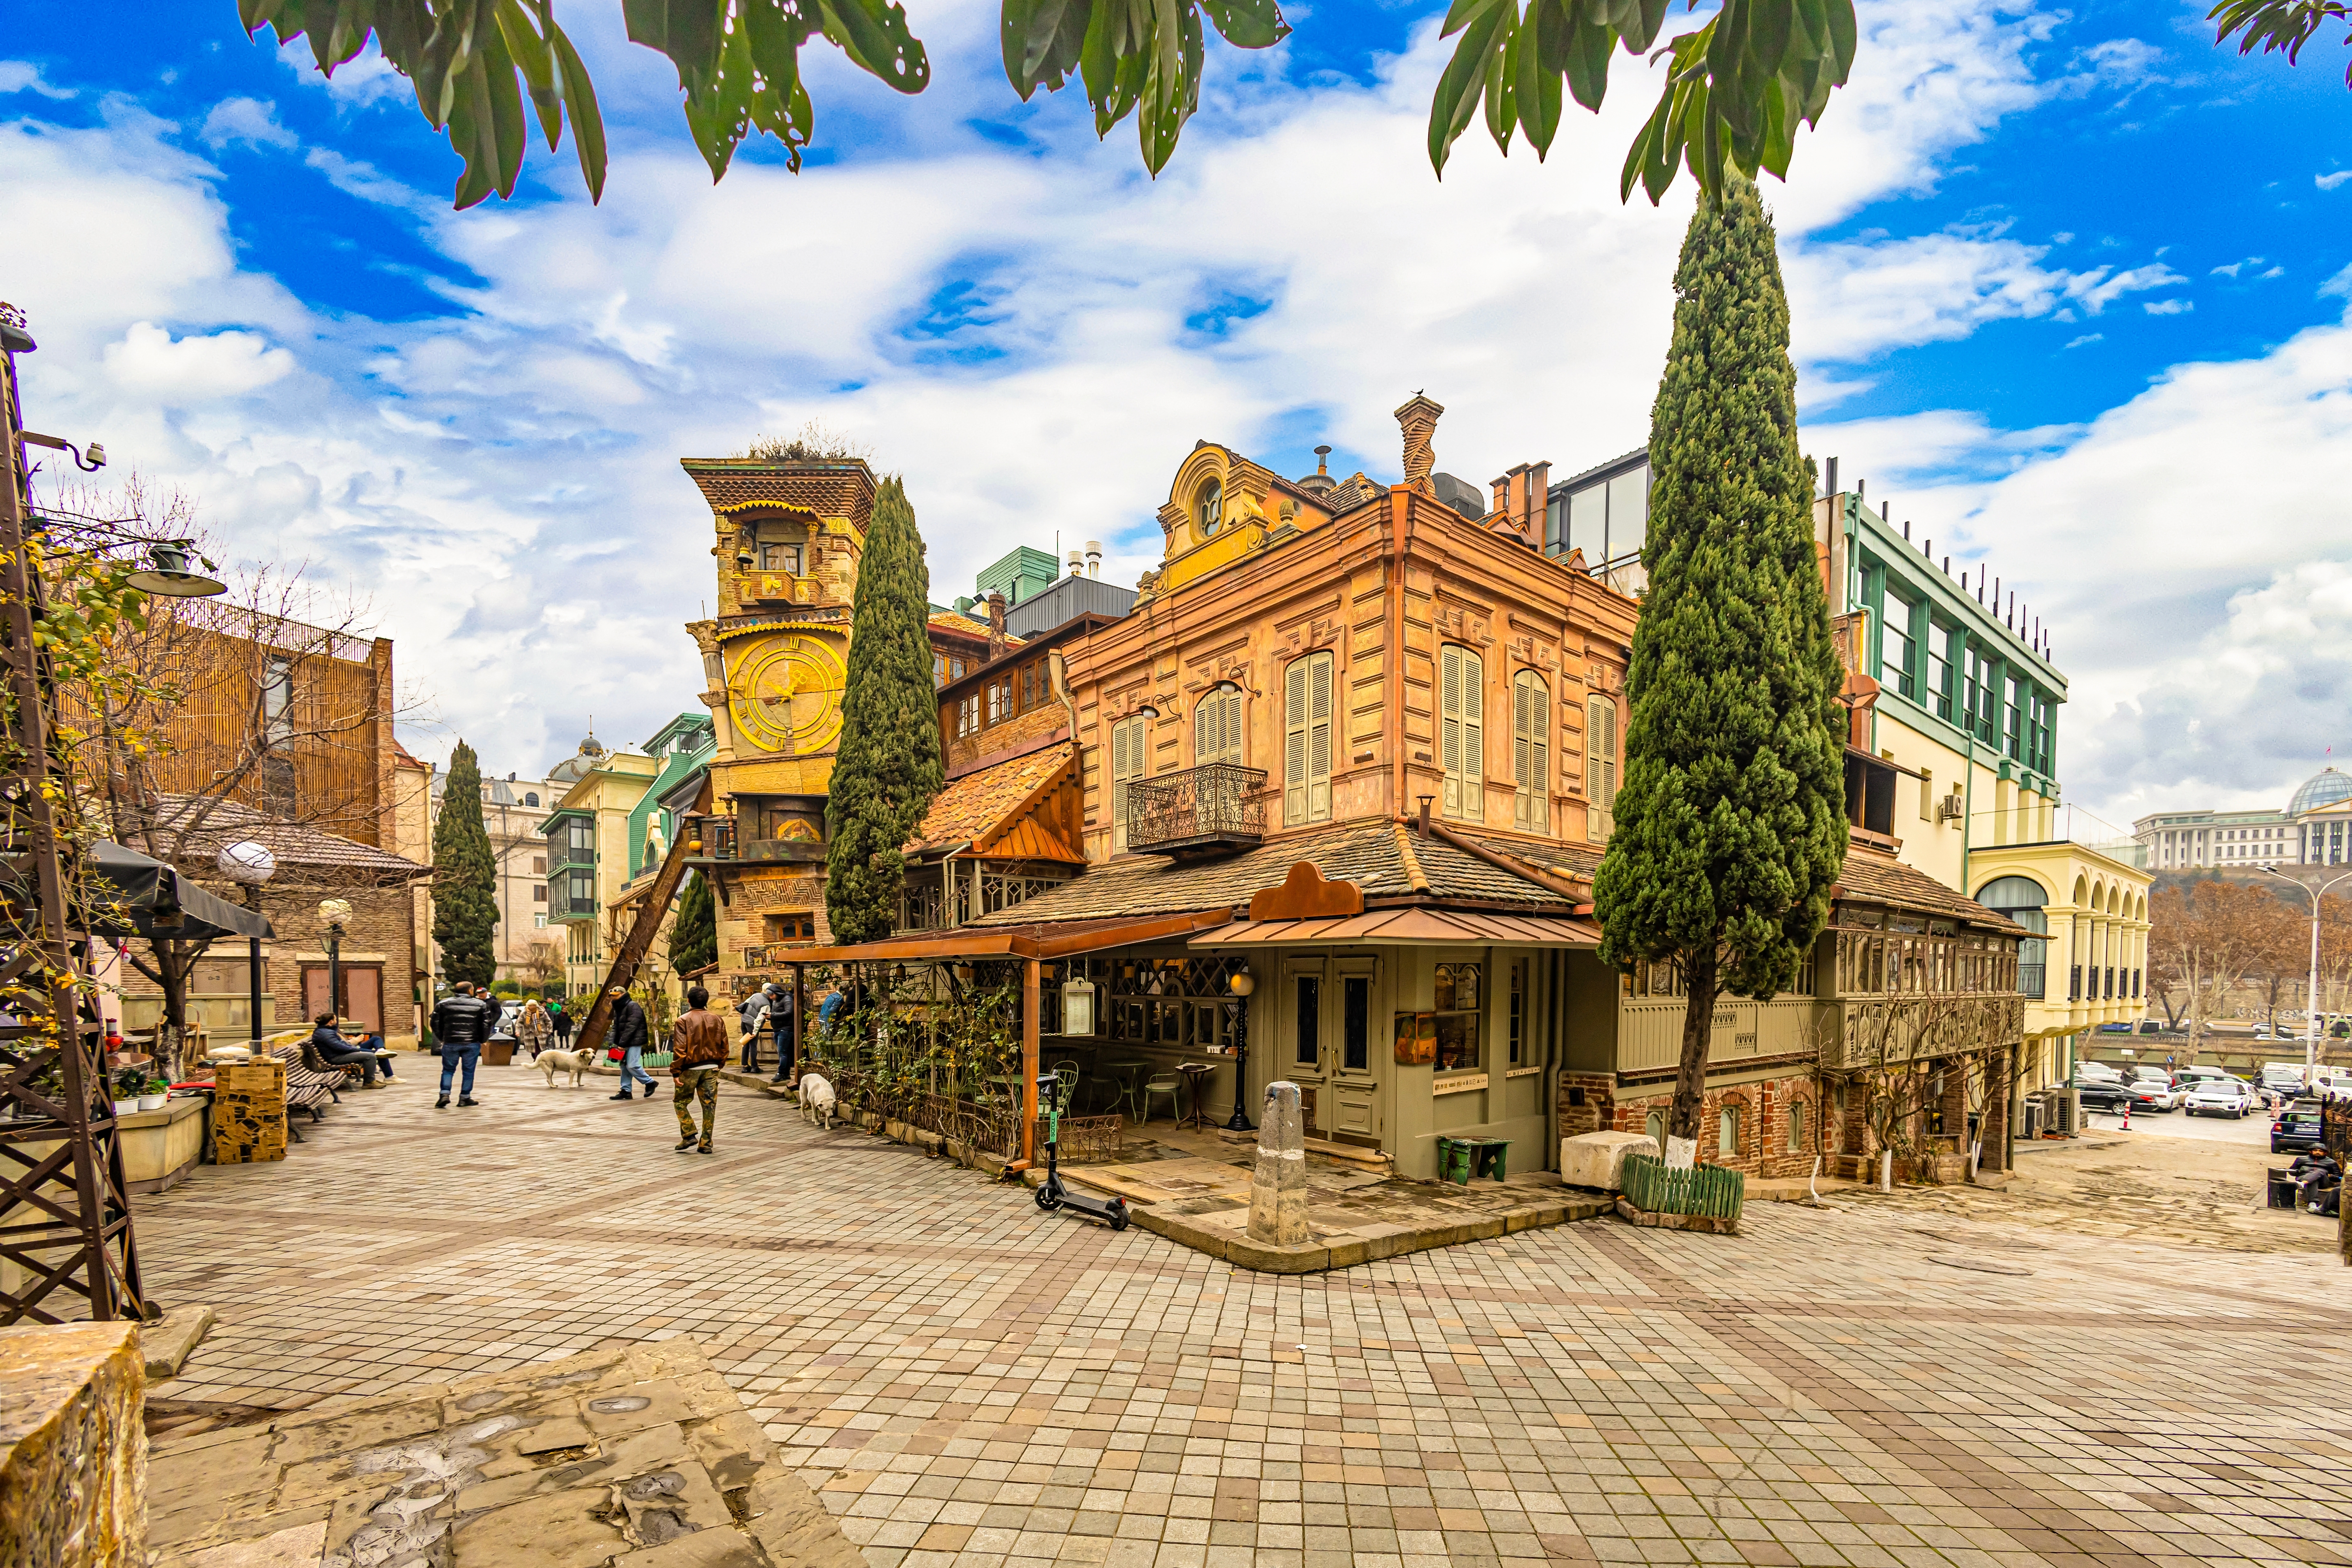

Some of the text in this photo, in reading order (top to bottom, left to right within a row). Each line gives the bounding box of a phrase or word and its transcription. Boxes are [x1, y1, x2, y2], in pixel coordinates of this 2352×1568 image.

[789, 636, 800, 649] XII
[833, 697, 841, 705] III
[737, 707, 747, 719] VIII
